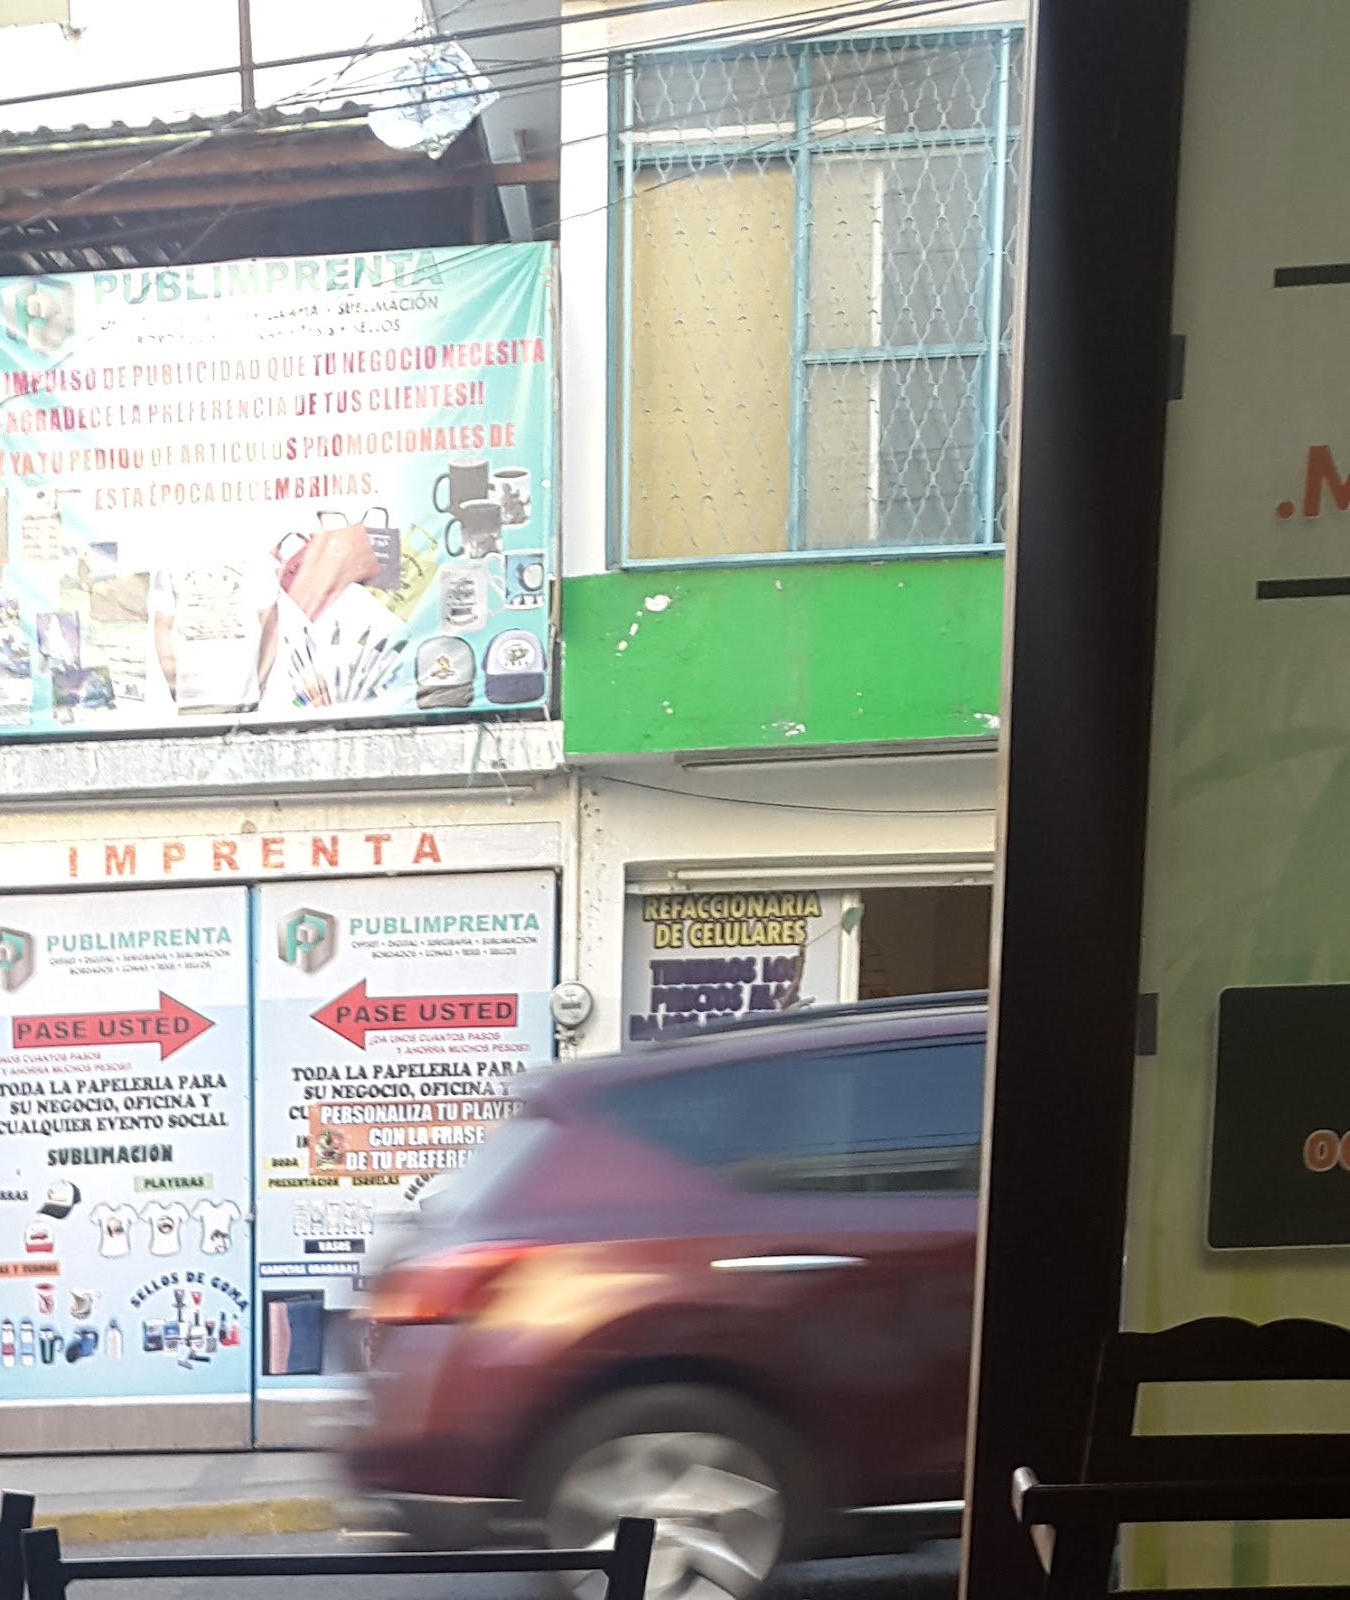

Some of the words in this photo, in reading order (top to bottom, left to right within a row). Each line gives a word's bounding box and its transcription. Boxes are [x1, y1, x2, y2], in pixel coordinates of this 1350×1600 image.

[93, 251, 445, 304] PUBLIMPRENTA
[4, 366, 97, 395] IMPULSO
[102, 366, 126, 390] DE
[132, 358, 261, 387] PUBLICIDAD
[267, 354, 306, 380] QUE
[313, 351, 337, 377] TU
[342, 344, 438, 374] NEGOCIO
[441, 337, 547, 368] NECESITA
[6, 405, 114, 433] AGRADECE
[119, 404, 142, 426] LA
[149, 395, 288, 425] PREFERENCIA
[294, 392, 318, 416] DE
[324, 389, 363, 414] TUS
[369, 380, 486, 412] CLIENTES!!
[10, 450, 35, 476] YA
[38, 449, 64, 475] TU
[69, 447, 145, 473] PEDIDO
[151, 445, 173, 466] DE
[181, 436, 298, 465] ARTICULOS
[303, 424, 485, 459] PROMOCIONALES
[490, 421, 517, 449] DE
[95, 487, 144, 511] ESTA
[150, 480, 216, 508] ÉPOCA
[221, 472, 380, 502] DECEMBRINAS.
[68, 832, 443, 878] IMPRENTA
[643, 891, 822, 922] REFACCIONARIA
[350, 913, 540, 936] PUBLIMPRENTA
[654, 921, 683, 949] DE
[688, 918, 808, 948] CELULARES
[47, 926, 233, 953] PUBLIMPRENTA
[336, 1004, 408, 1025] PASE
[419, 1001, 514, 1023] USTED
[17, 1020, 88, 1041] PASE
[97, 1016, 191, 1038] USTED
[419, 1031, 467, 1043] CUANTOS
[404, 1045, 447, 1056] AHORRA
[291, 1065, 341, 1082] TODA
[344, 1064, 369, 1081] LA
[371, 1061, 472, 1080] PAPELERIA
[476, 1059, 529, 1077] PARA
[49, 1079, 73, 1096] LA
[76, 1076, 174, 1095] PAPELERIA
[178, 1073, 228, 1091] PARA
[303, 1083, 328, 1101] SU
[331, 1082, 416, 1101] NEGOCIO,
[419, 1080, 497, 1098] OFICINA
[9, 1099, 32, 1116] SU
[37, 1096, 120, 1115] NEGOCIO,
[123, 1093, 197, 1112] OFICINA
[201, 1092, 213, 1108] Y
[320, 1103, 434, 1125] PERSONALIZA
[436, 1102, 458, 1121] TU
[462, 1100, 526, 1121] PLAYER
[97, 1113, 164, 1133] EVENTO
[168, 1111, 228, 1130] SOCIAL
[369, 1127, 406, 1148] CON
[408, 1127, 429, 1146] LA
[431, 1124, 485, 1146] FRASE
[47, 1144, 174, 1168] SUBLIMACION
[345, 1151, 368, 1171] DE
[370, 1150, 394, 1171] TU
[143, 1175, 206, 1191] PLAYERAS
[318, 1240, 352, 1253] VASOS
[129, 1270, 180, 1310] SELLOS
[184, 1270, 206, 1285] DE
[210, 1275, 251, 1314] GOMA
